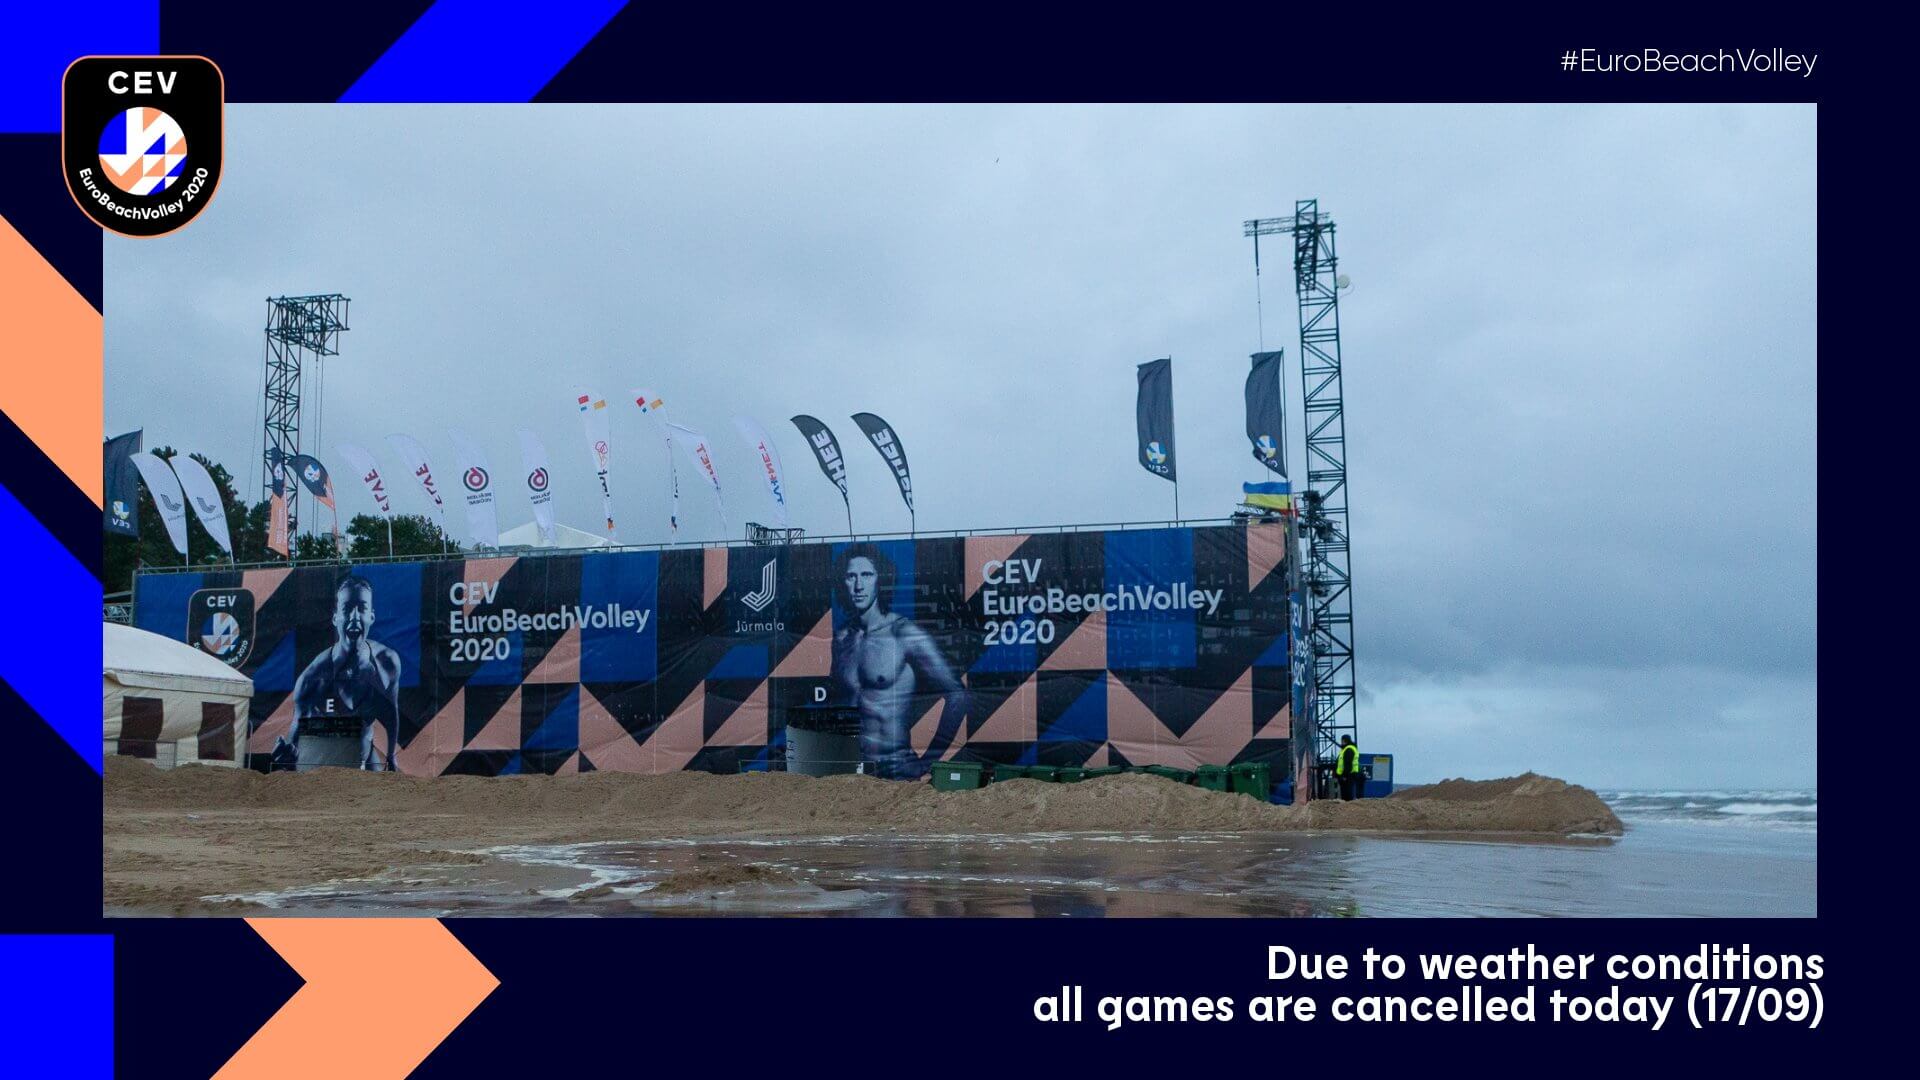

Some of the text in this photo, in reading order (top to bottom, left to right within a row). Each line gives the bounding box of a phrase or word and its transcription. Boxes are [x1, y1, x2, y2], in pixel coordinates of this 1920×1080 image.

[982, 558, 1042, 585] CEV
[206, 595, 237, 607] CEV
[450, 581, 499, 606] CEV
[983, 582, 1223, 616] EuroBeachVolley
[450, 603, 650, 634] EuroBeachVolley
[983, 619, 1055, 646] 2020
[450, 637, 510, 661] 2020
[326, 699, 334, 712] E
[814, 687, 827, 702] D
